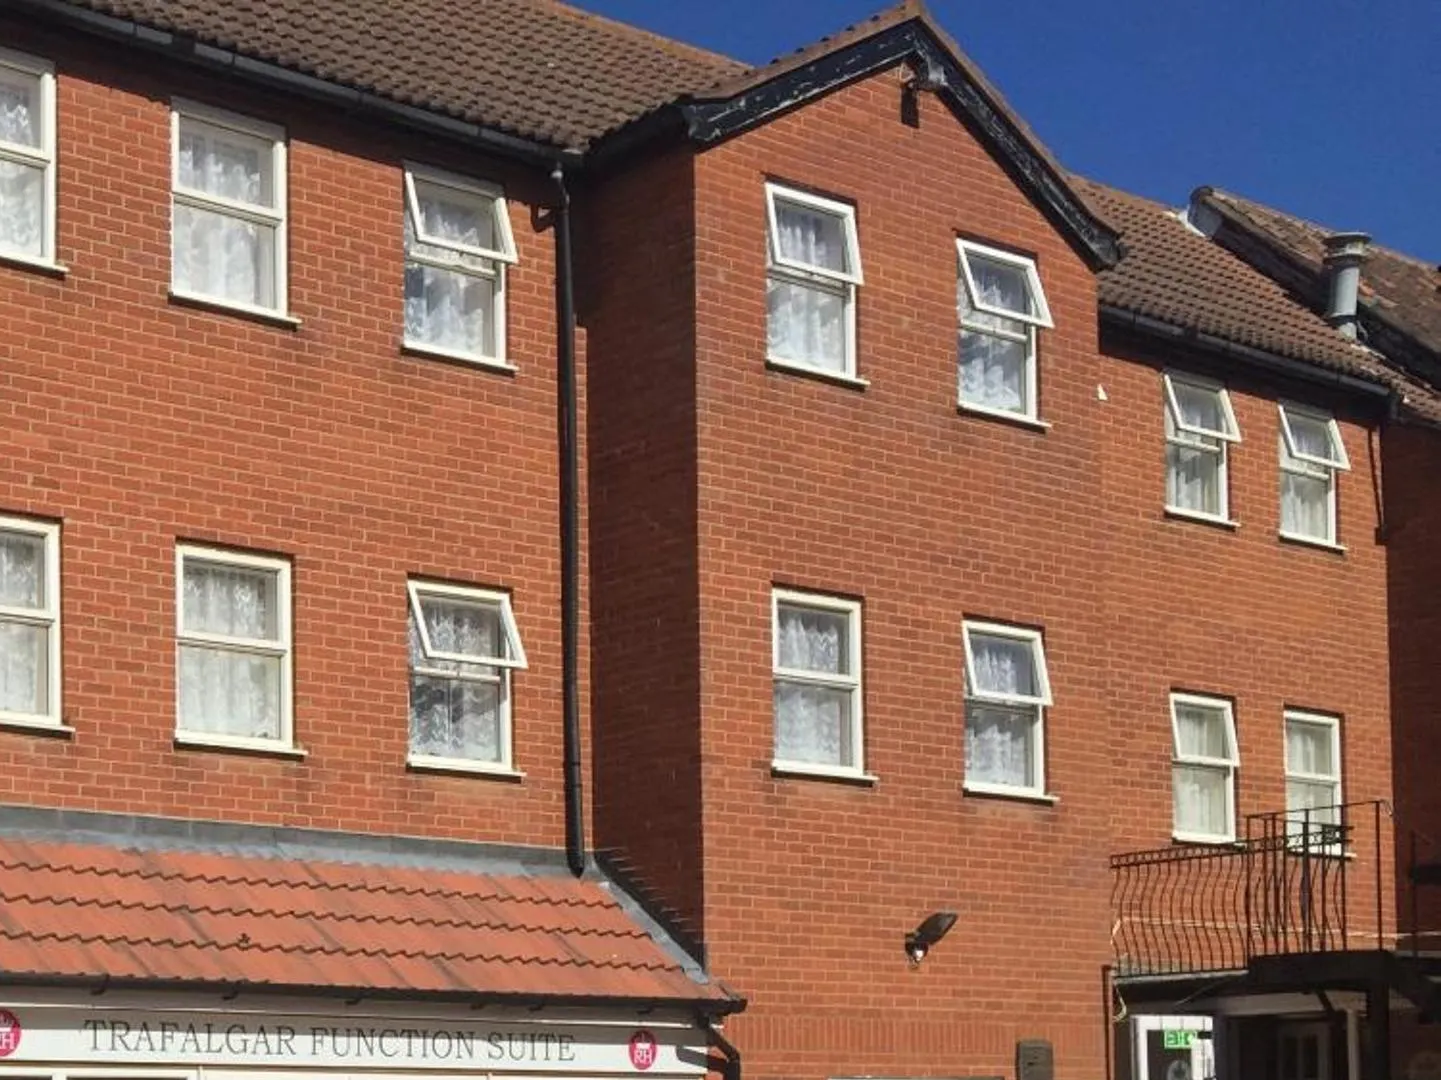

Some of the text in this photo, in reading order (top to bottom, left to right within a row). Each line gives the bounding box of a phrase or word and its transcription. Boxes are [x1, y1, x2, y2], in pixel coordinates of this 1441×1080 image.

[83, 1018, 576, 1062] TRAFALGAR FUNCTION SUITE
